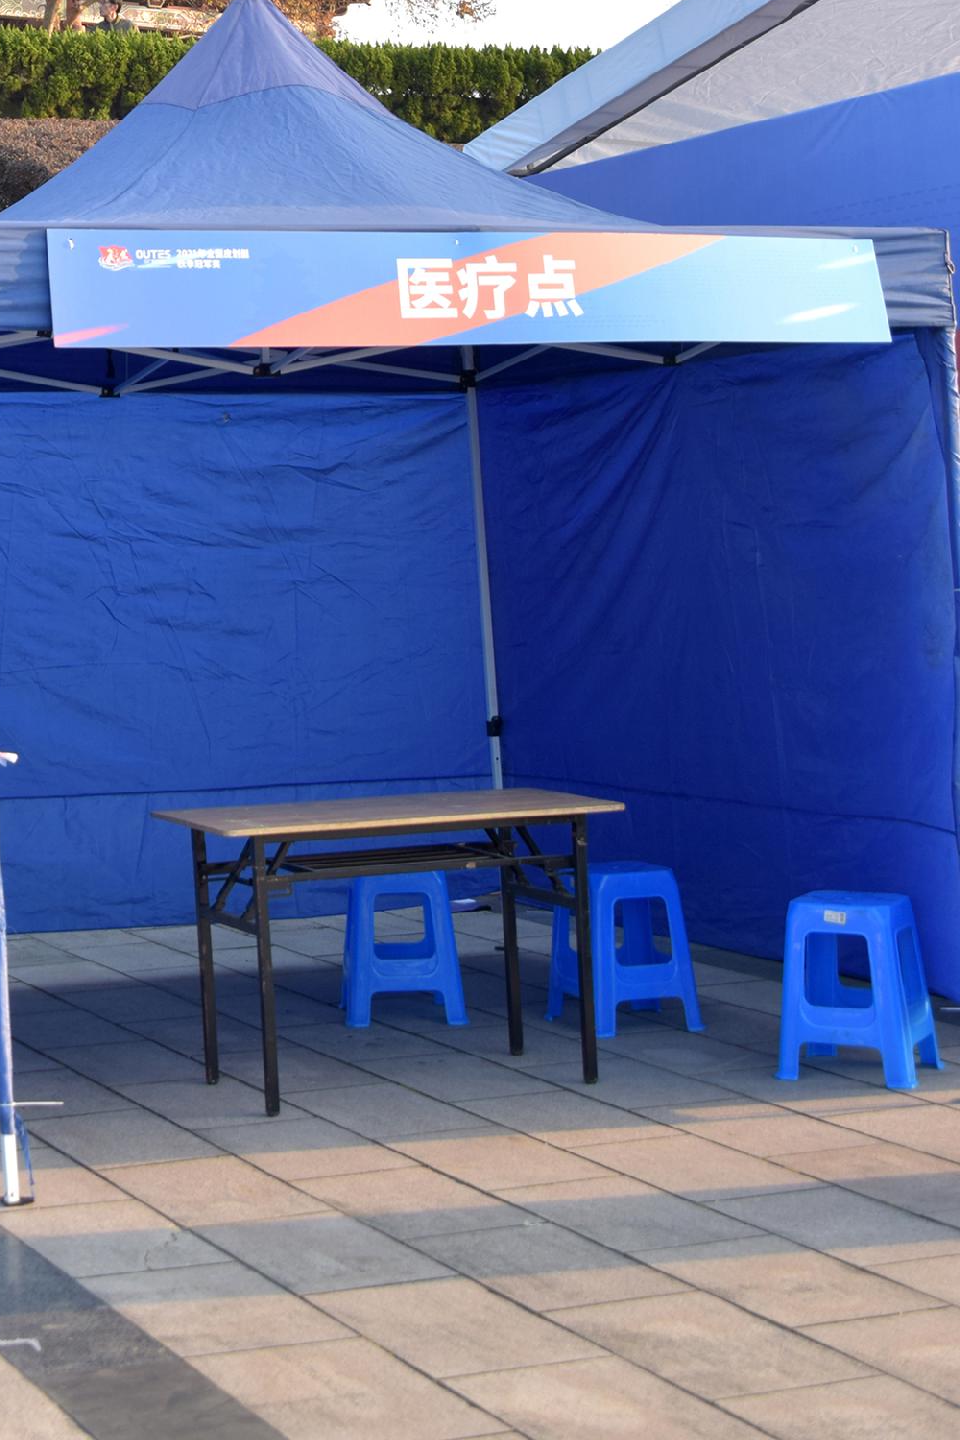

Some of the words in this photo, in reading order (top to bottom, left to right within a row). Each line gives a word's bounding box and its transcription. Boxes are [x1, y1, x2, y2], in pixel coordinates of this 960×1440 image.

[135, 249, 171, 259] OUTES
[396, 254, 585, 320] 医疗点
